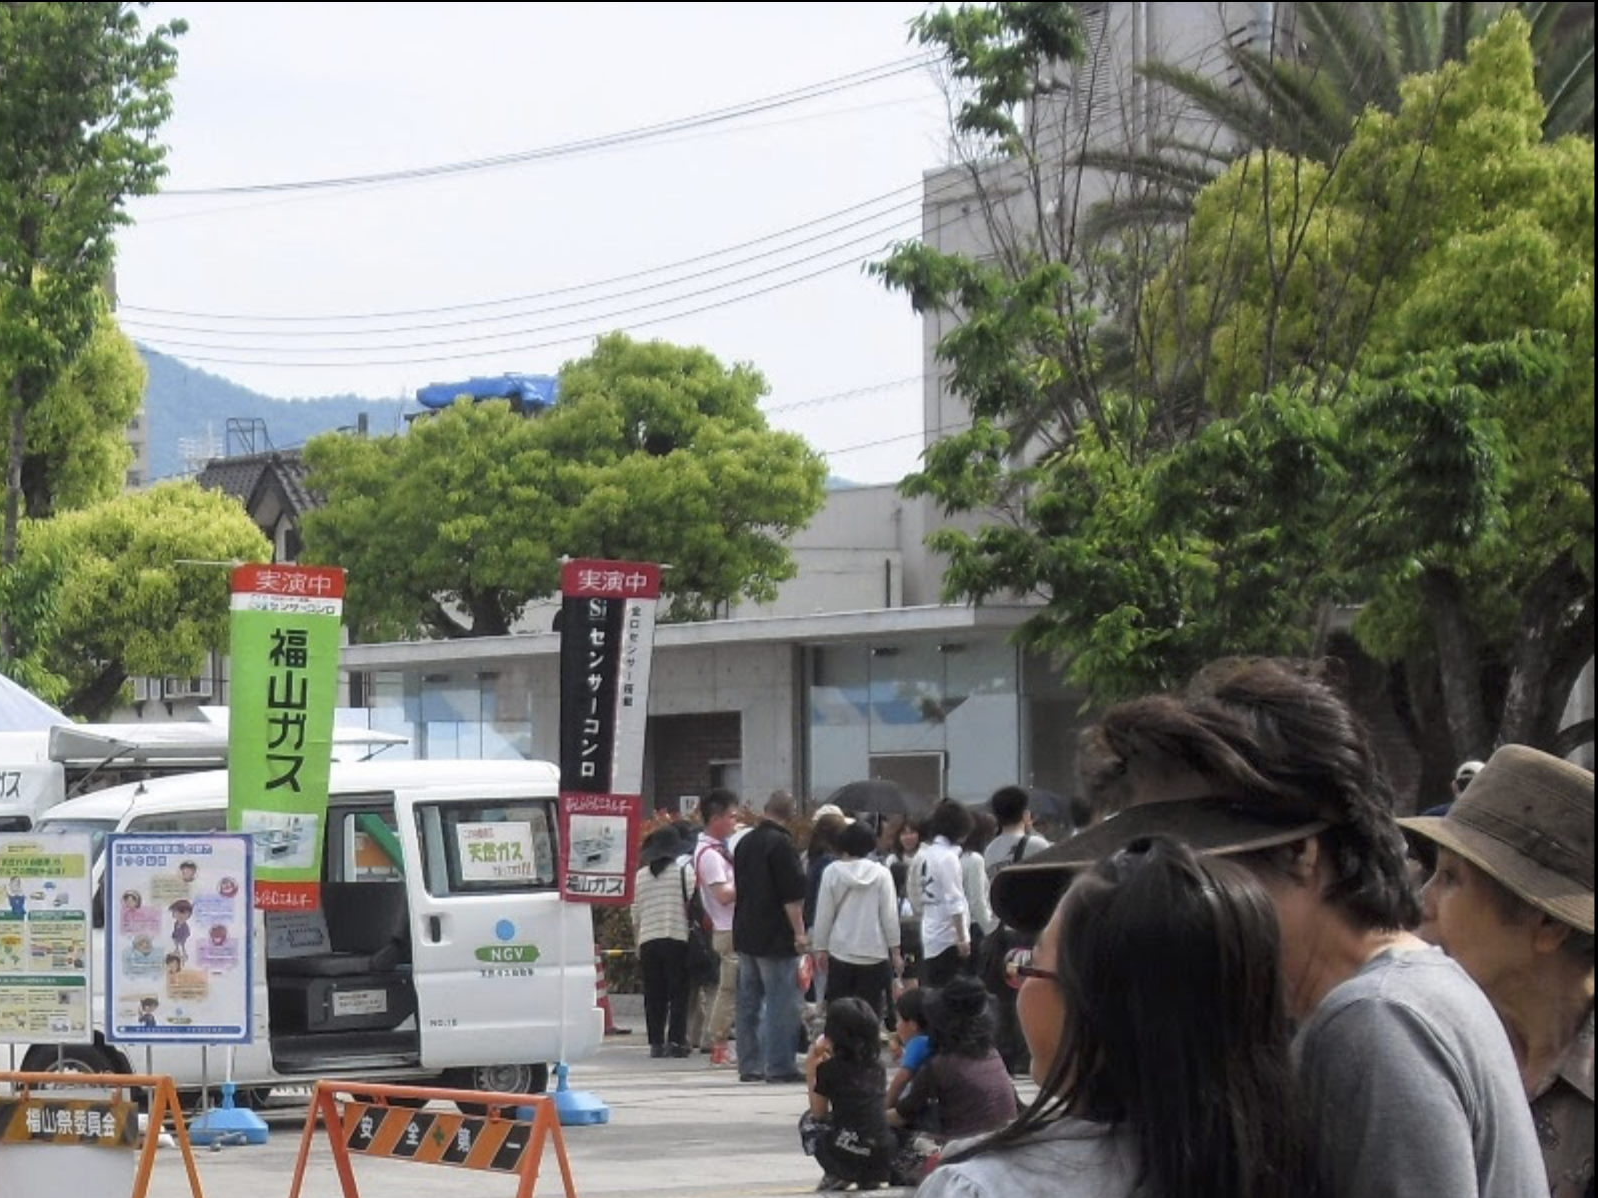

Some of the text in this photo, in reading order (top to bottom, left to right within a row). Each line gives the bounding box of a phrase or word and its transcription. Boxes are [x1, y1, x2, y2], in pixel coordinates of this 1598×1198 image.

[256, 569, 331, 595] 実演中
[578, 569, 647, 593] 実演中
[264, 628, 309, 793] 福山ガス
[581, 628, 606, 778] センサーコンロ
[467, 841, 523, 863] 天然ガス
[567, 875, 624, 894] 福山ガス
[492, 947, 524, 961] NGV
[26, 1107, 117, 1138] 福山祭委員会
[359, 1115, 521, 1153] 安全第一
